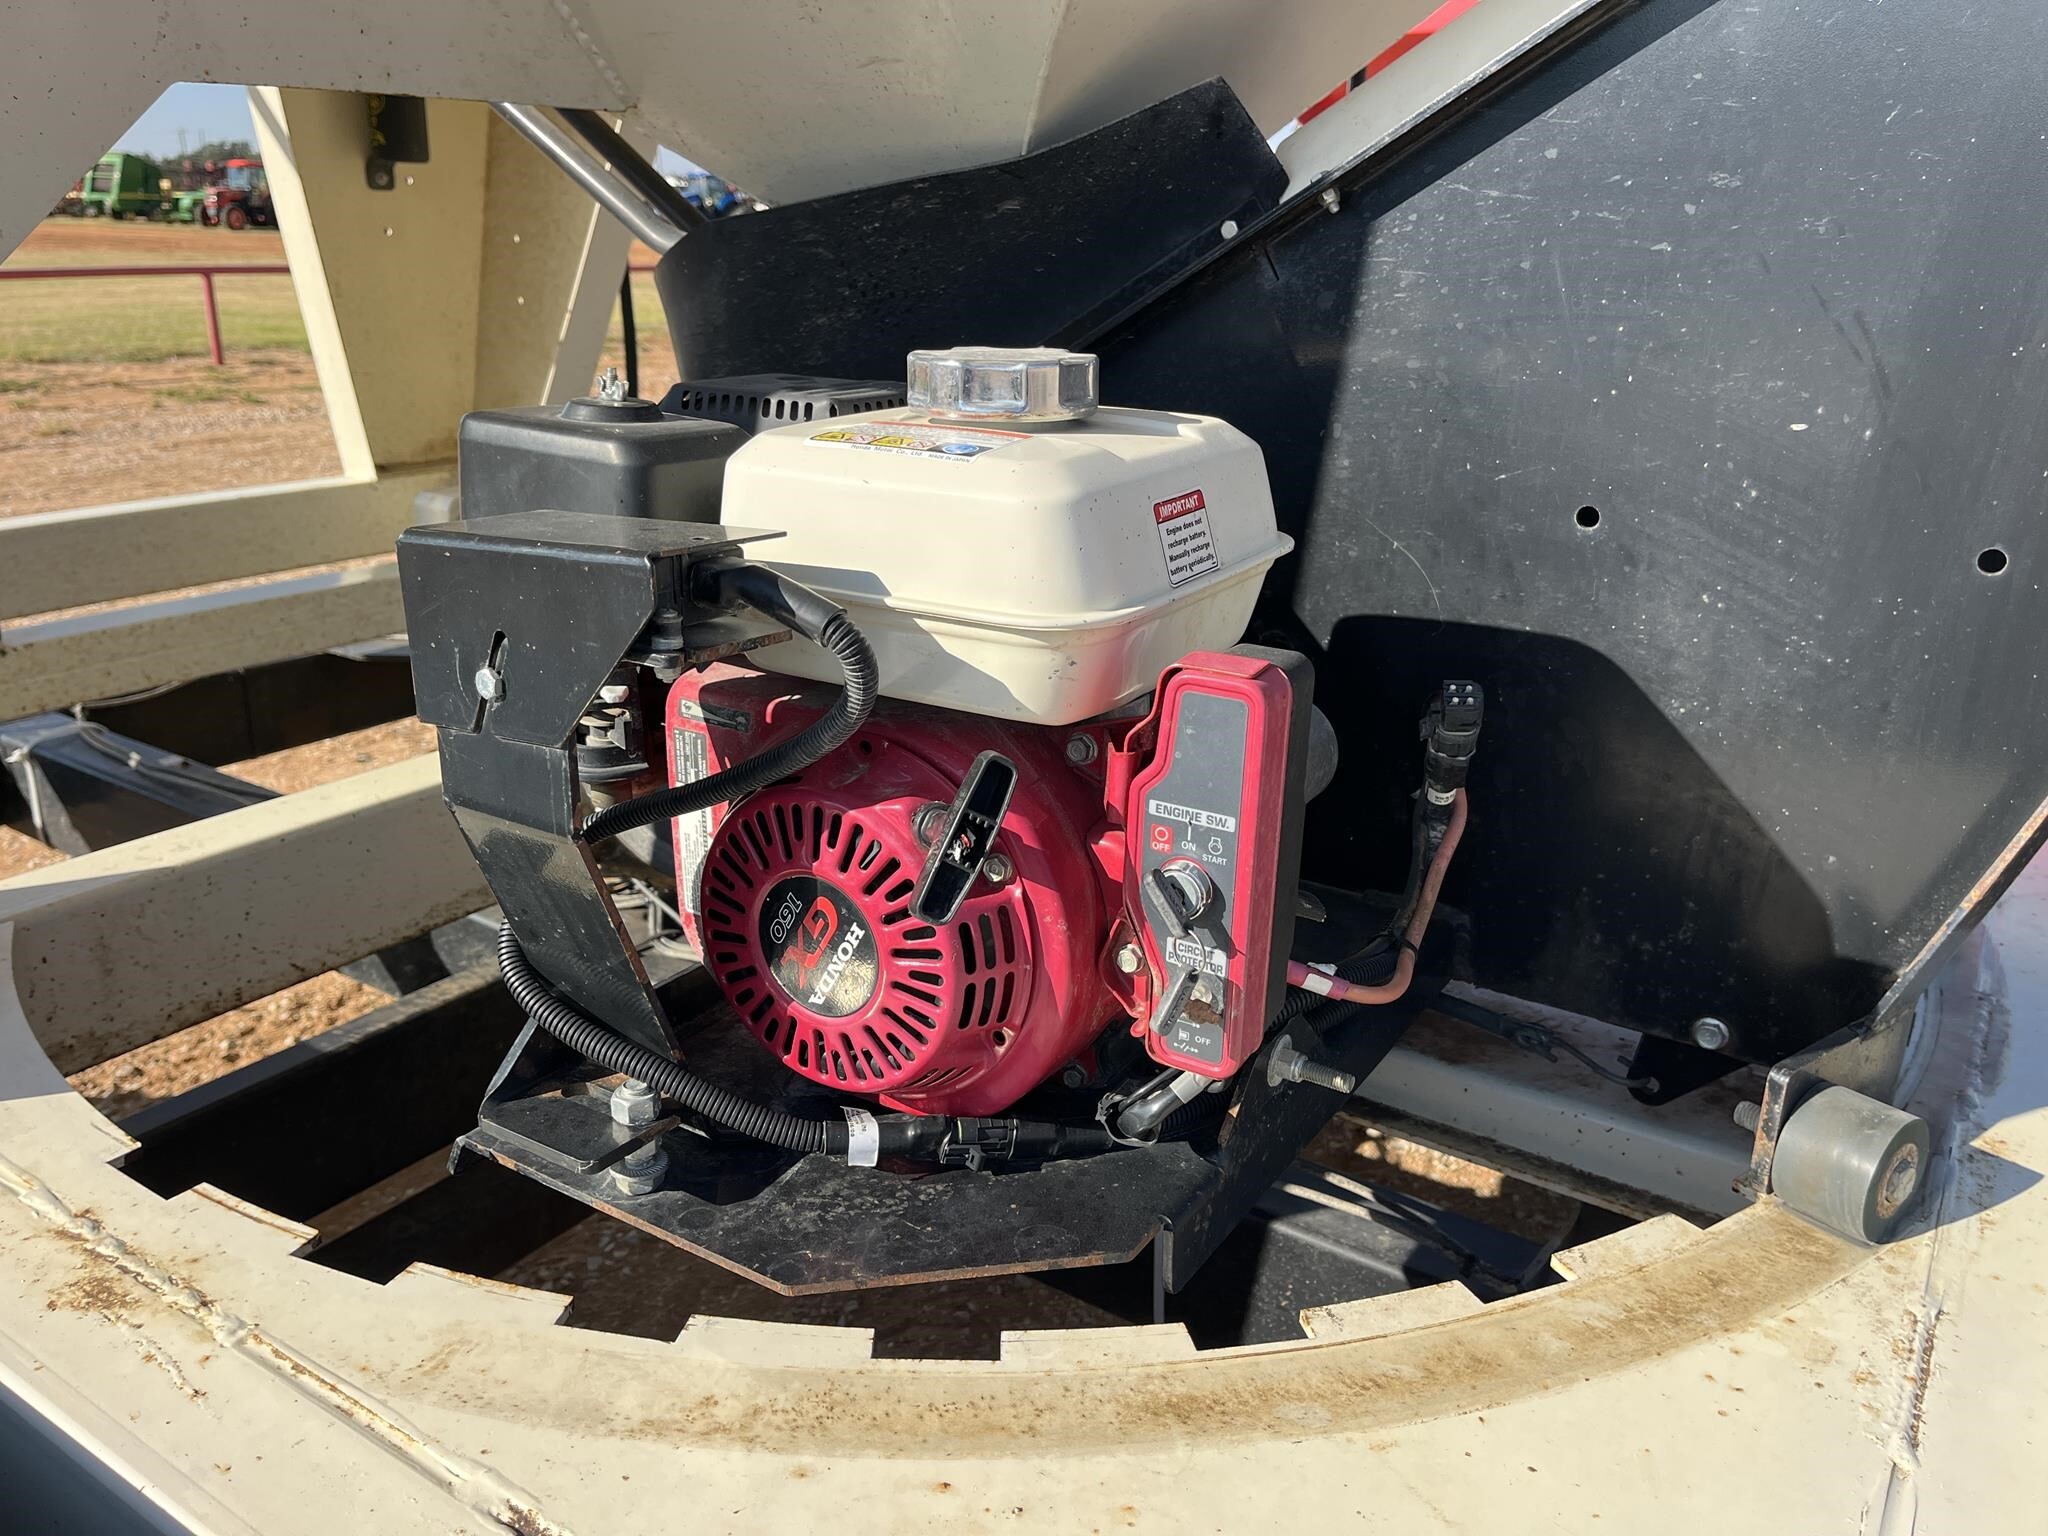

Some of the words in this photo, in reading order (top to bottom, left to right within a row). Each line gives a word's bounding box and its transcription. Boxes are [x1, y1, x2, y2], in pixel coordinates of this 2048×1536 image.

[1158, 494, 1199, 520] IMPORTANT
[1166, 525, 1182, 536] Engine
[1183, 522, 1194, 530] does
[1195, 518, 1203, 526] not
[1168, 536, 1188, 549] recharge
[1169, 548, 1190, 563] Manually
[1191, 542, 1210, 554] recharge
[1170, 564, 1188, 576] battery
[1155, 803, 1202, 823] ENGINE
[1206, 815, 1229, 829] SW.
[1152, 841, 1170, 852] OFF
[1181, 841, 1196, 851] ON
[1202, 853, 1227, 866] START
[770, 892, 802, 943] 160
[808, 922, 865, 1005] HONDA
[1195, 1035, 1211, 1046] OFF
